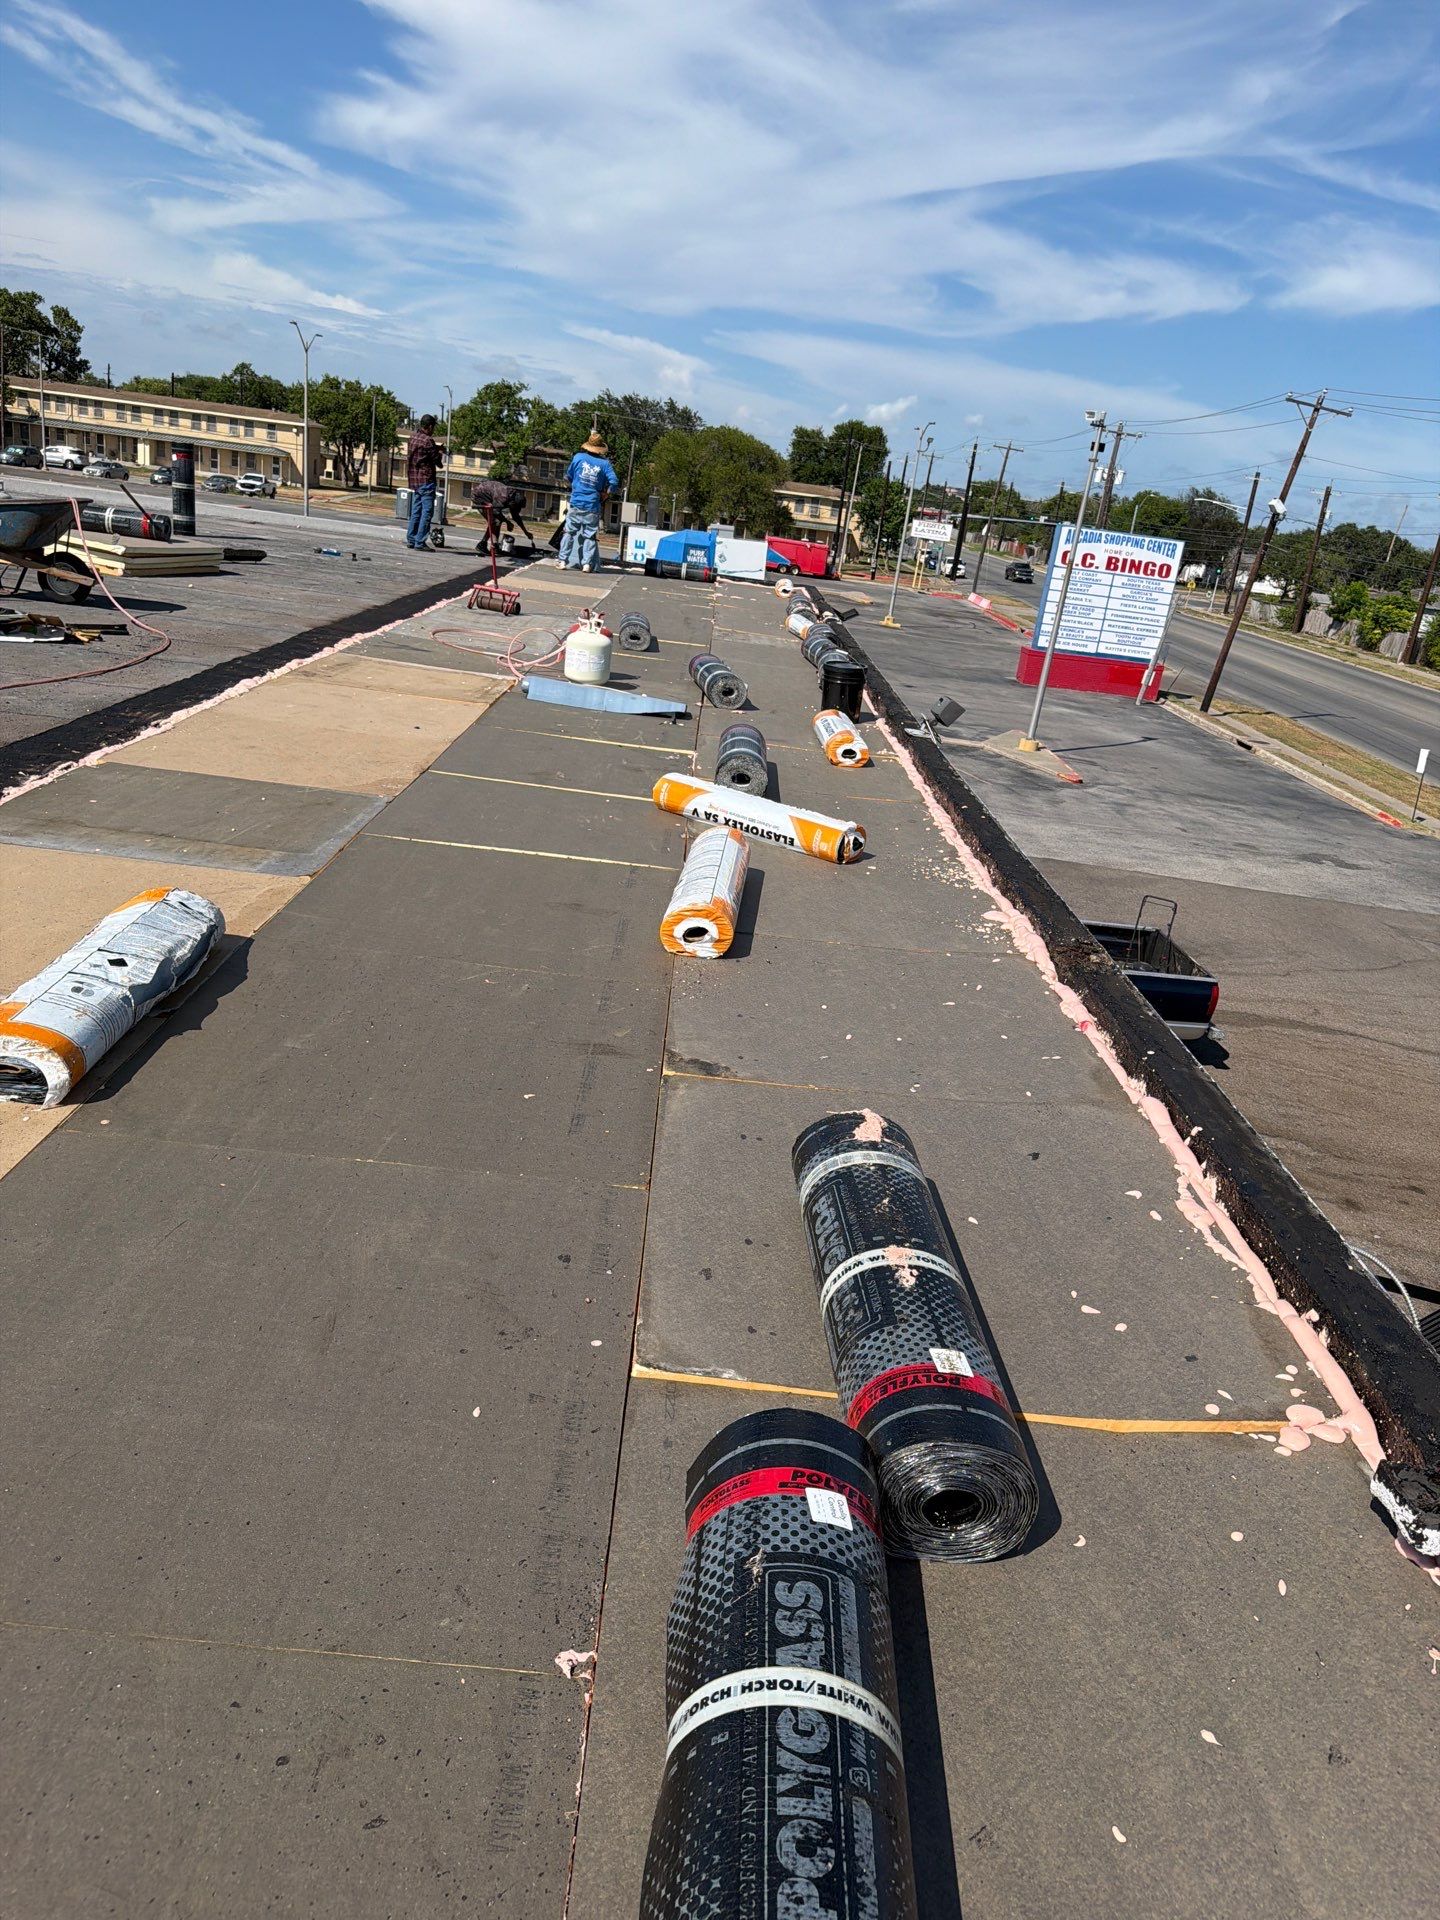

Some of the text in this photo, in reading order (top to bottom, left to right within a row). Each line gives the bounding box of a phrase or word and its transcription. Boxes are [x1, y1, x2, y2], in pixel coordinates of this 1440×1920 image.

[915, 527, 947, 536] LATINA
[917, 521, 947, 530] FIESTA
[1103, 533, 1145, 550] SHOPPING
[1146, 540, 1177, 559] CENTER
[1104, 548, 1123, 556] HOME
[686, 555, 708, 564] WATER
[1105, 555, 1172, 579] BINGO
[691, 807, 700, 818] V
[704, 810, 719, 823] SA
[722, 817, 795, 847] ELASTOFLEX
[873, 1374, 962, 1399] POLYFLEX
[701, 1478, 752, 1512] POLYGLASS
[741, 1678, 873, 1717] WHITE/TORCH
[774, 1580, 837, 1920] POLYGASS
